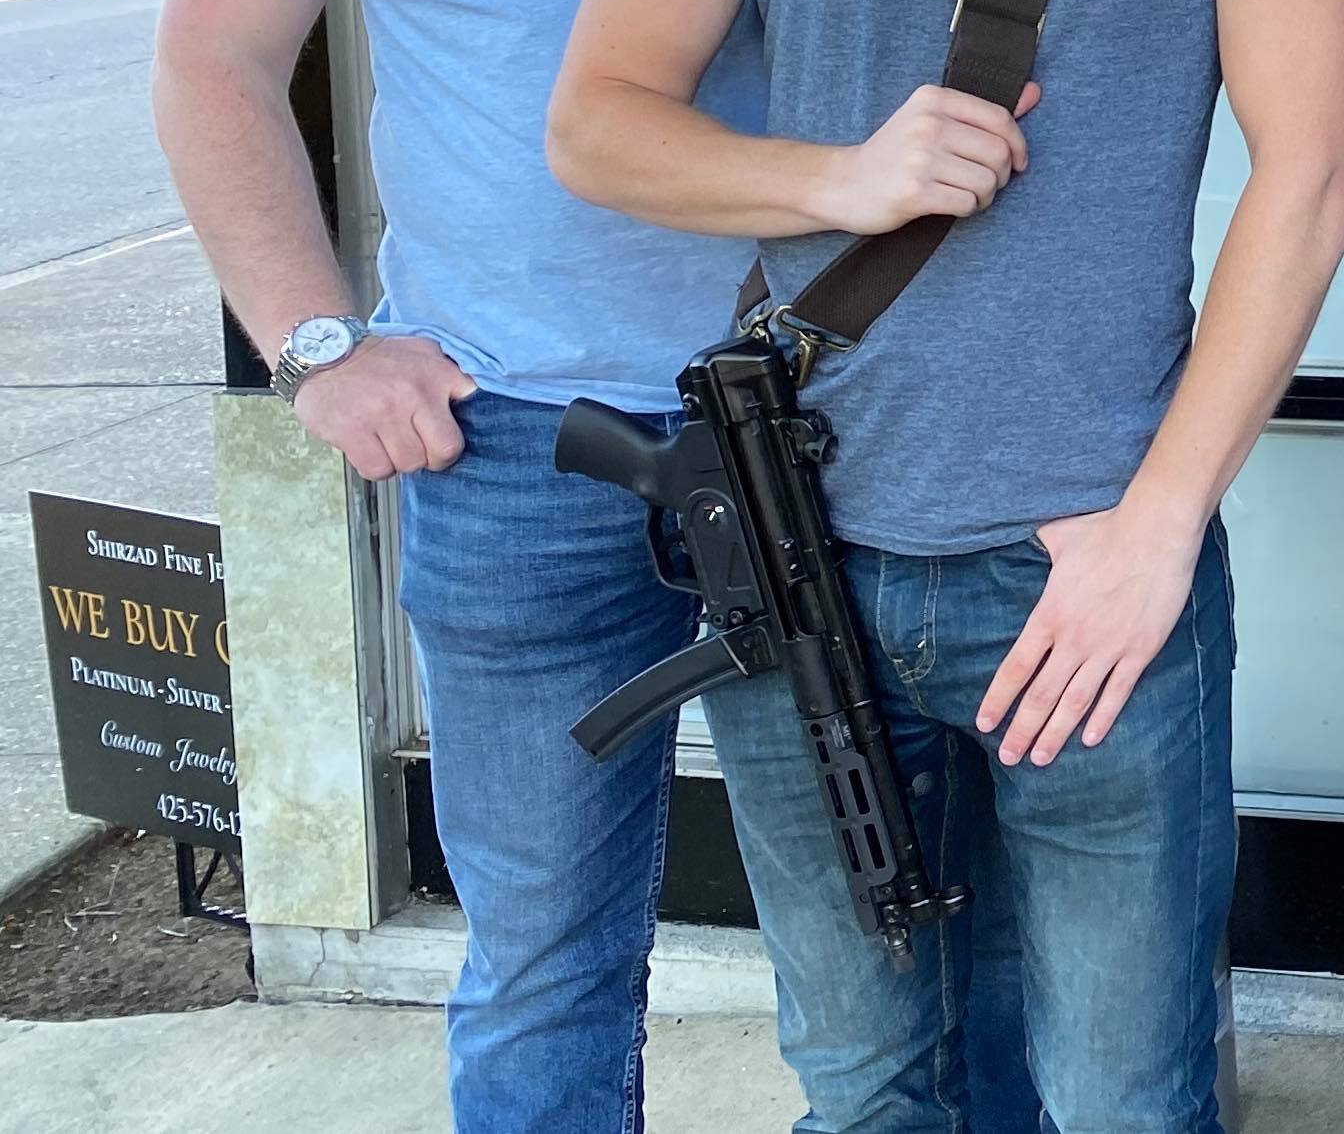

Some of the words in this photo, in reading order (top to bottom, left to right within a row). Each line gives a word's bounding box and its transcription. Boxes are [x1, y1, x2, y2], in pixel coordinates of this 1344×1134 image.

[87, 530, 157, 566] SHIRZAD
[163, 544, 204, 576] FINE
[207, 553, 224, 583] JE
[49, 586, 110, 639] WE
[121, 599, 200, 658] BUY
[70, 657, 155, 698] PLATINUM
[165, 678, 223, 714] SILVER
[100, 720, 164, 759] Custom
[169, 738, 239, 785] Jewelry
[156, 793, 241, 837] 425-576-12
